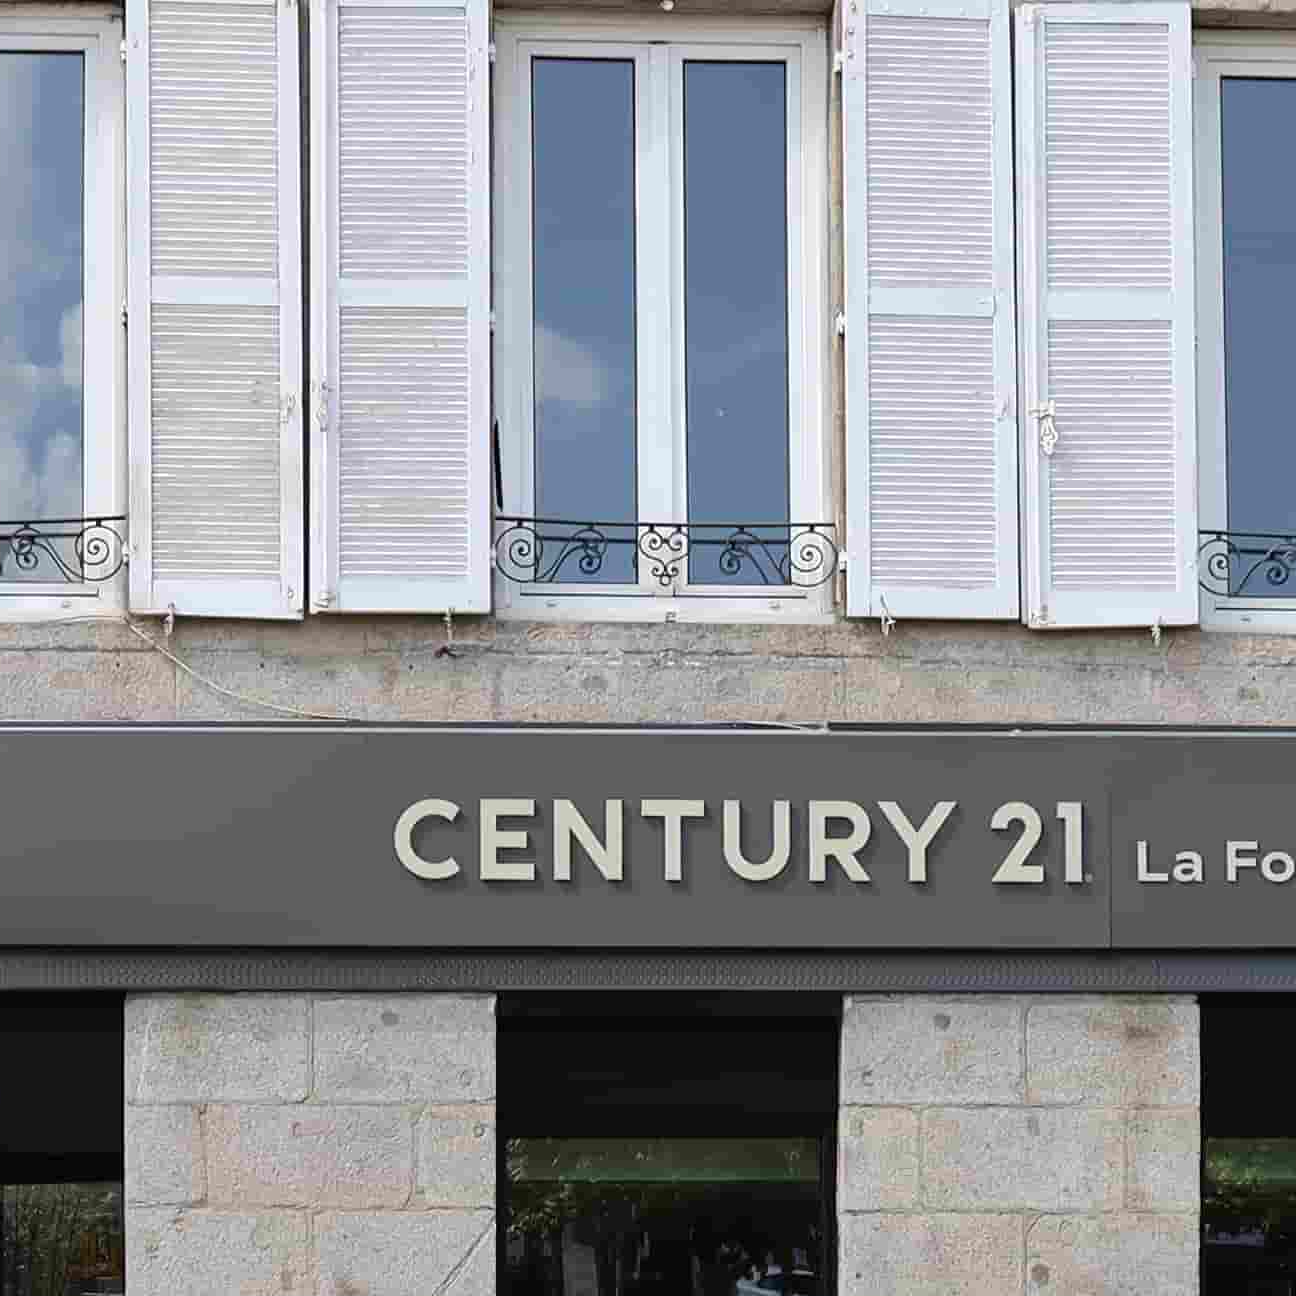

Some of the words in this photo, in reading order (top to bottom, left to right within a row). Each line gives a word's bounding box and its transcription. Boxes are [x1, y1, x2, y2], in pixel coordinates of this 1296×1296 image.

[393, 798, 957, 882] CENTURY
[990, 800, 1088, 884] 21
[1136, 841, 1203, 883] La
